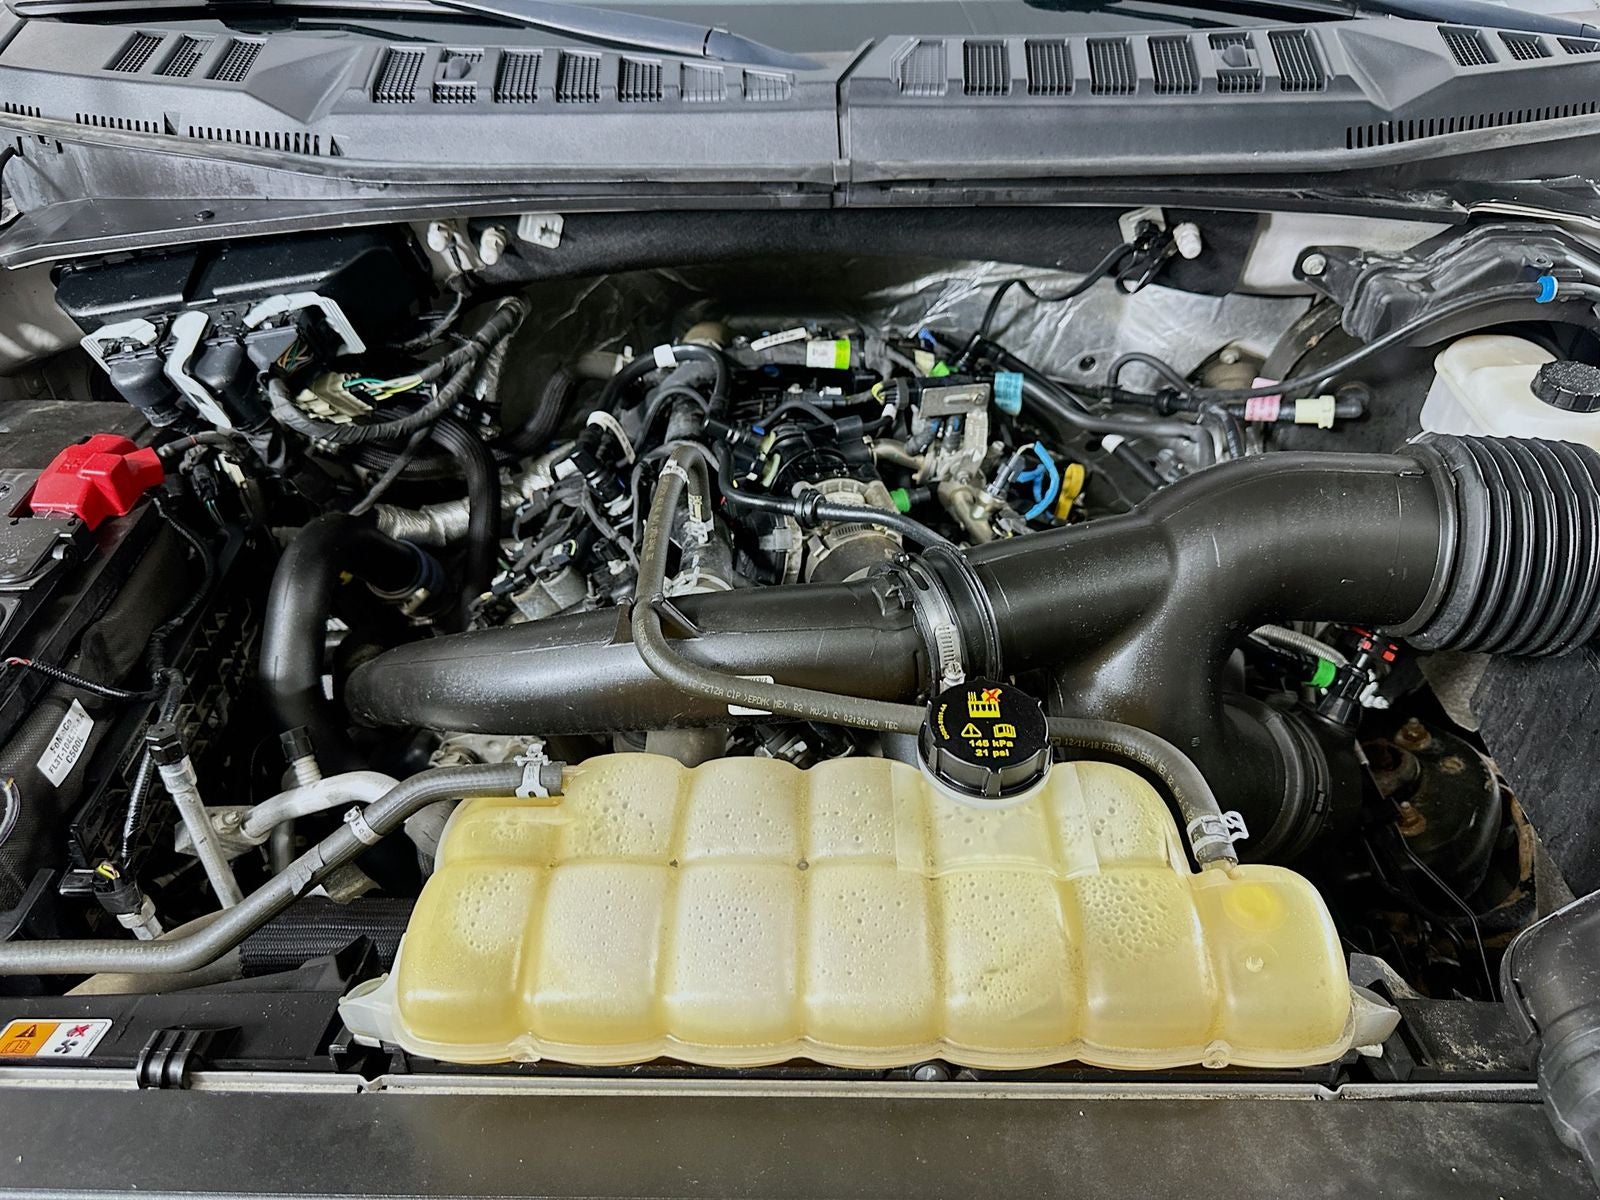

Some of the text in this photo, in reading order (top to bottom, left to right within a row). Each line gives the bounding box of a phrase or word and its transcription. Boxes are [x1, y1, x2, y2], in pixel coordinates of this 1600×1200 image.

[884, 720, 899, 730] TEC
[969, 739, 1014, 747] 145 kPa
[975, 749, 1009, 758] 21 psi
